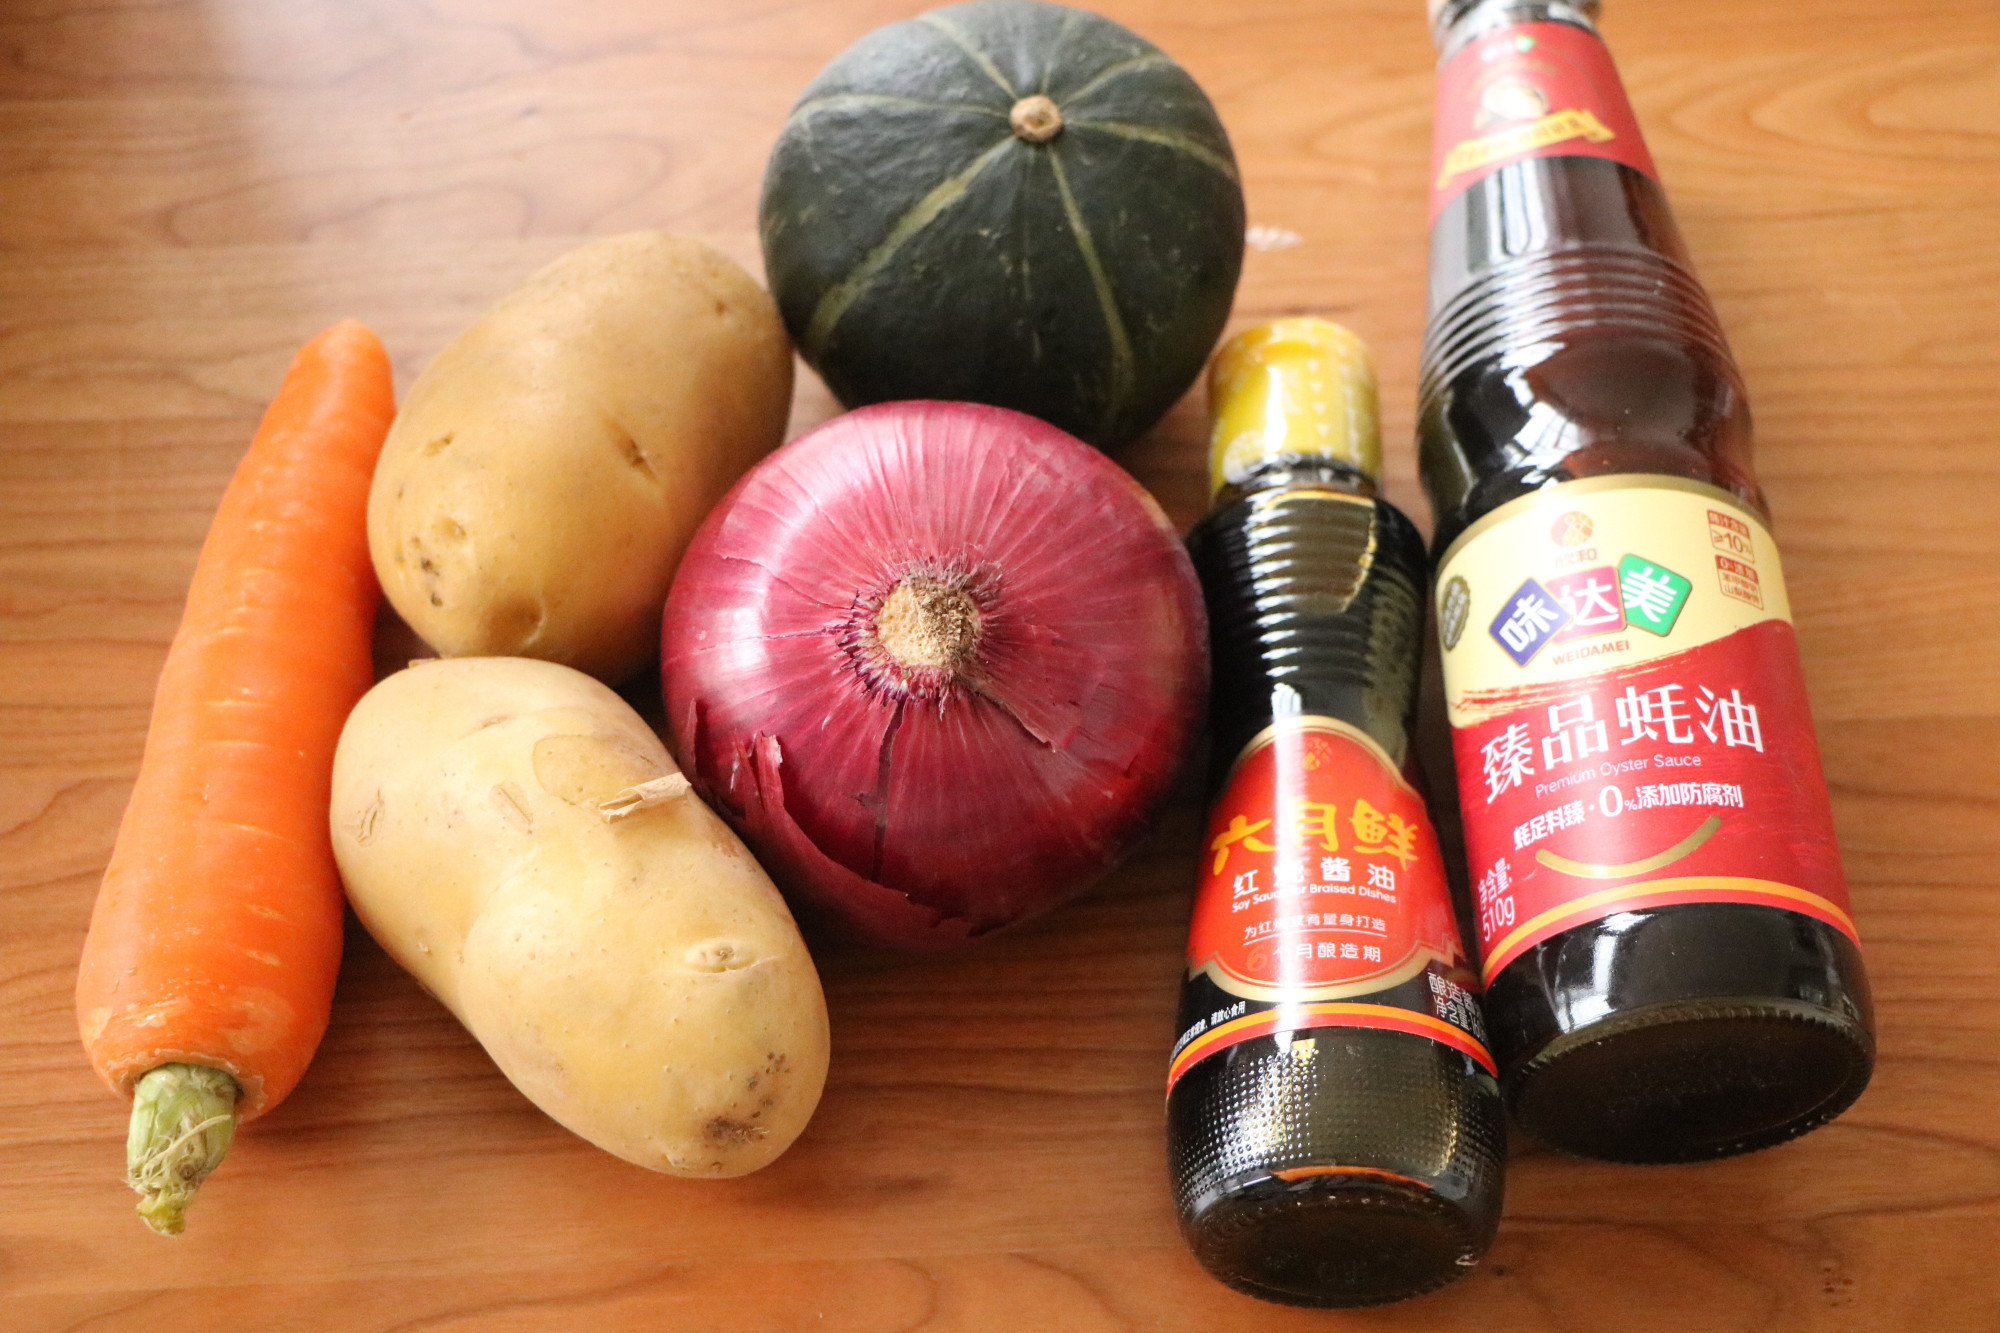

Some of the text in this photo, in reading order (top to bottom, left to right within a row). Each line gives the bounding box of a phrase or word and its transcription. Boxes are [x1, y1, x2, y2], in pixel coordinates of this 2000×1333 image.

[1498, 566, 1678, 654] 味达美
[1553, 640, 1630, 666] WEIDAMEI
[1480, 683, 1764, 805] 臻品蚝油
[1536, 753, 1702, 799] Premium Oyster Sauce
[1232, 898, 1251, 913] Soy
[1309, 882, 1356, 895] Braised
[1358, 885, 1397, 904] Dishes
[1481, 894, 1516, 942] 510g
